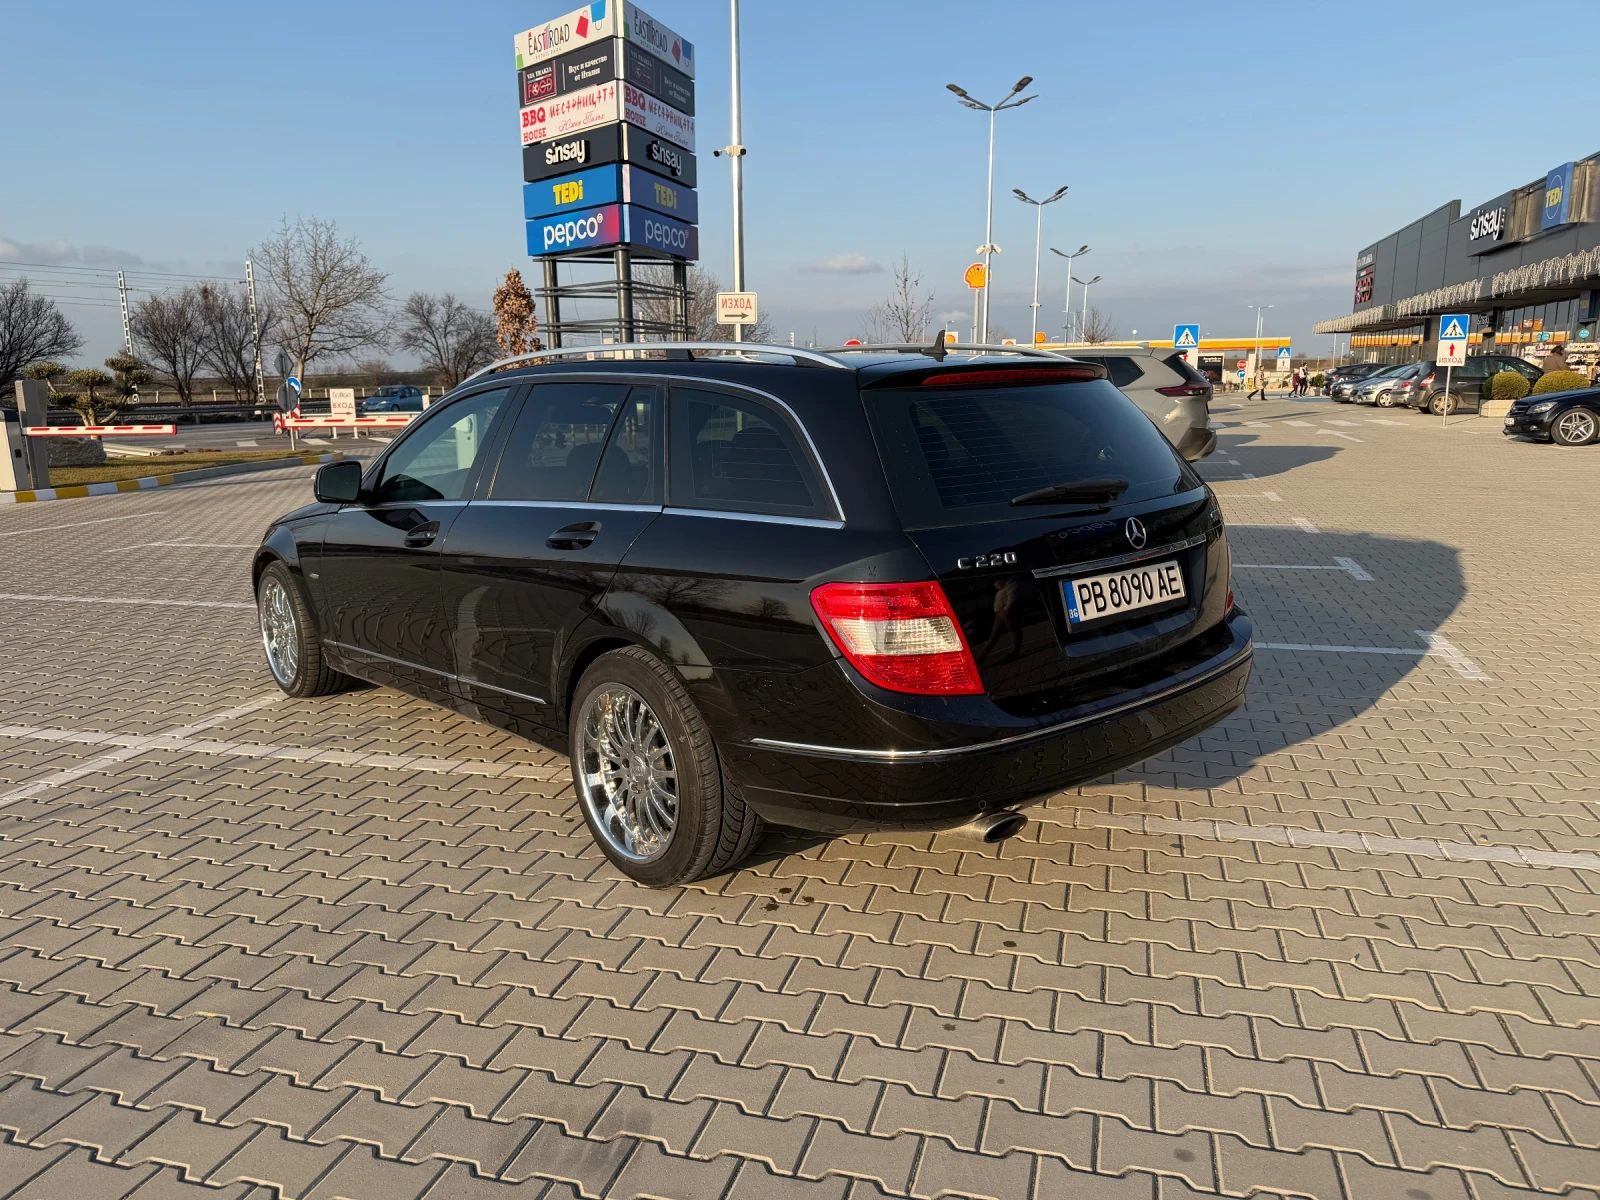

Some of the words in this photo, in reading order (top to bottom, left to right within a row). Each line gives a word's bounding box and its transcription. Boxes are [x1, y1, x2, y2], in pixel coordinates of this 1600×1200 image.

[549, 24, 570, 48] ROAD
[527, 78, 553, 98] FOOD
[624, 84, 646, 112] BBQ
[522, 106, 546, 128] BBQ
[625, 107, 647, 127] HOUSE
[523, 127, 547, 142] HOUSE
[545, 139, 586, 165] sinsay
[651, 140, 682, 176] sinsay
[552, 179, 584, 205] TEDi
[654, 182, 677, 209] TEDi
[1545, 186, 1564, 208] TEDi
[1469, 206, 1502, 240] sinsay
[721, 297, 752, 310] ИЗХОД
[1438, 356, 1463, 364] ИЗХОД
[957, 557, 971, 570] C
[975, 551, 1018, 568] 220
[1078, 580, 1107, 617] PB
[1109, 571, 1155, 609] 8090
[1158, 565, 1182, 599] AE
[1068, 608, 1080, 619] BG
